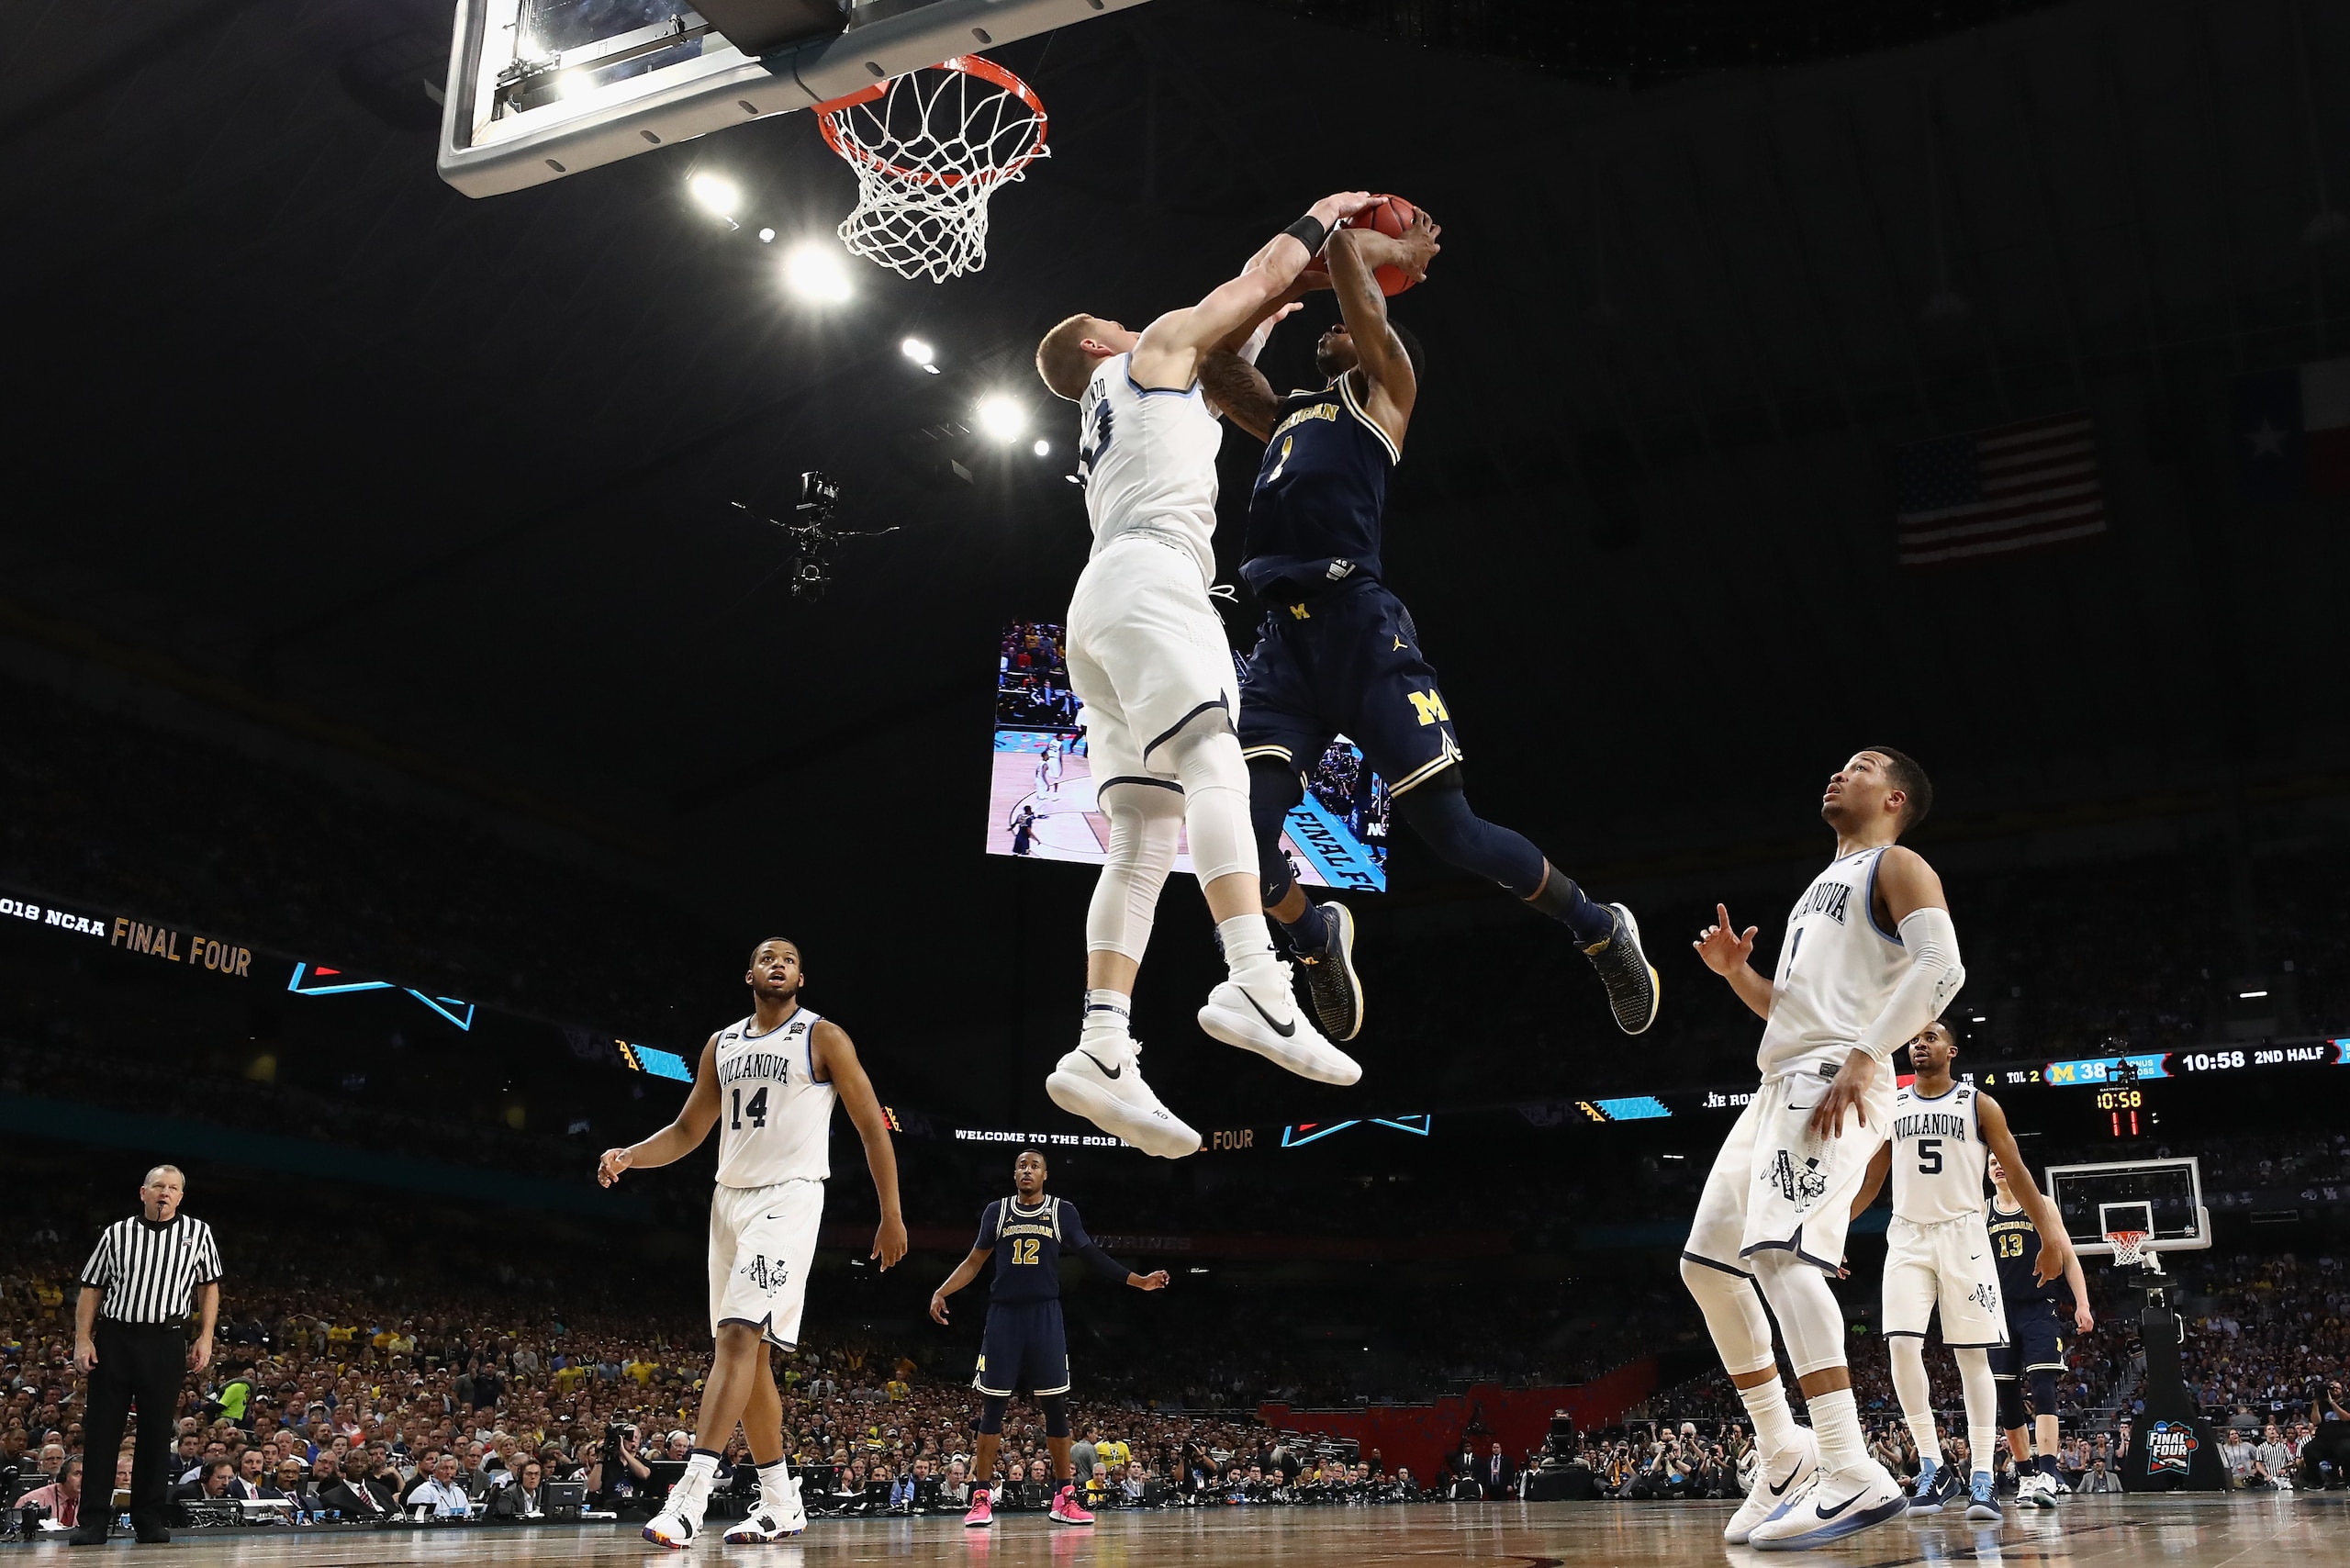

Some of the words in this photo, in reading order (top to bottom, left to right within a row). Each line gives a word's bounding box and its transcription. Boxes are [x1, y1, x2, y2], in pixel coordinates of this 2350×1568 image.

[1335, 558, 1348, 567] 46
[1290, 602, 1311, 621] M
[1407, 688, 1449, 726] M
[1288, 812, 1356, 868] FINAL
[45, 909, 106, 936] NCAA
[110, 917, 181, 962] FINAL
[189, 935, 252, 978] FOUR
[2126, 1059, 2154, 1070] ONUS
[2182, 1051, 2246, 1071] 10:58
[2254, 1049, 2284, 1065] 2ND
[2287, 1047, 2325, 1062] HALF
[719, 1053, 790, 1087] VILLANOVA
[1985, 1073, 1996, 1086] 4
[2007, 1070, 2027, 1084] TOL
[2029, 1070, 2041, 1082] 2
[2051, 1064, 2076, 1083] M
[2079, 1062, 2107, 1080] 38
[731, 1086, 768, 1130] 14
[2097, 1091, 2143, 1110] 10:58
[1894, 1113, 1966, 1143] VILLANOVA
[2112, 1110, 2139, 1137] 11
[955, 1128, 1026, 1144] WELCOME
[1028, 1134, 1047, 1144] TO
[1051, 1135, 1080, 1146] THE
[1082, 1136, 1117, 1147] 2018
[1214, 1128, 1254, 1151] FOUR
[1918, 1138, 1942, 1174] 5
[1002, 1224, 1054, 1238] MICHIGAN
[1011, 1238, 1041, 1265] 12
[1998, 1233, 2024, 1258] 13
[2149, 1431, 2186, 1446] FINAL
[2153, 1444, 2188, 1457] FOUR
